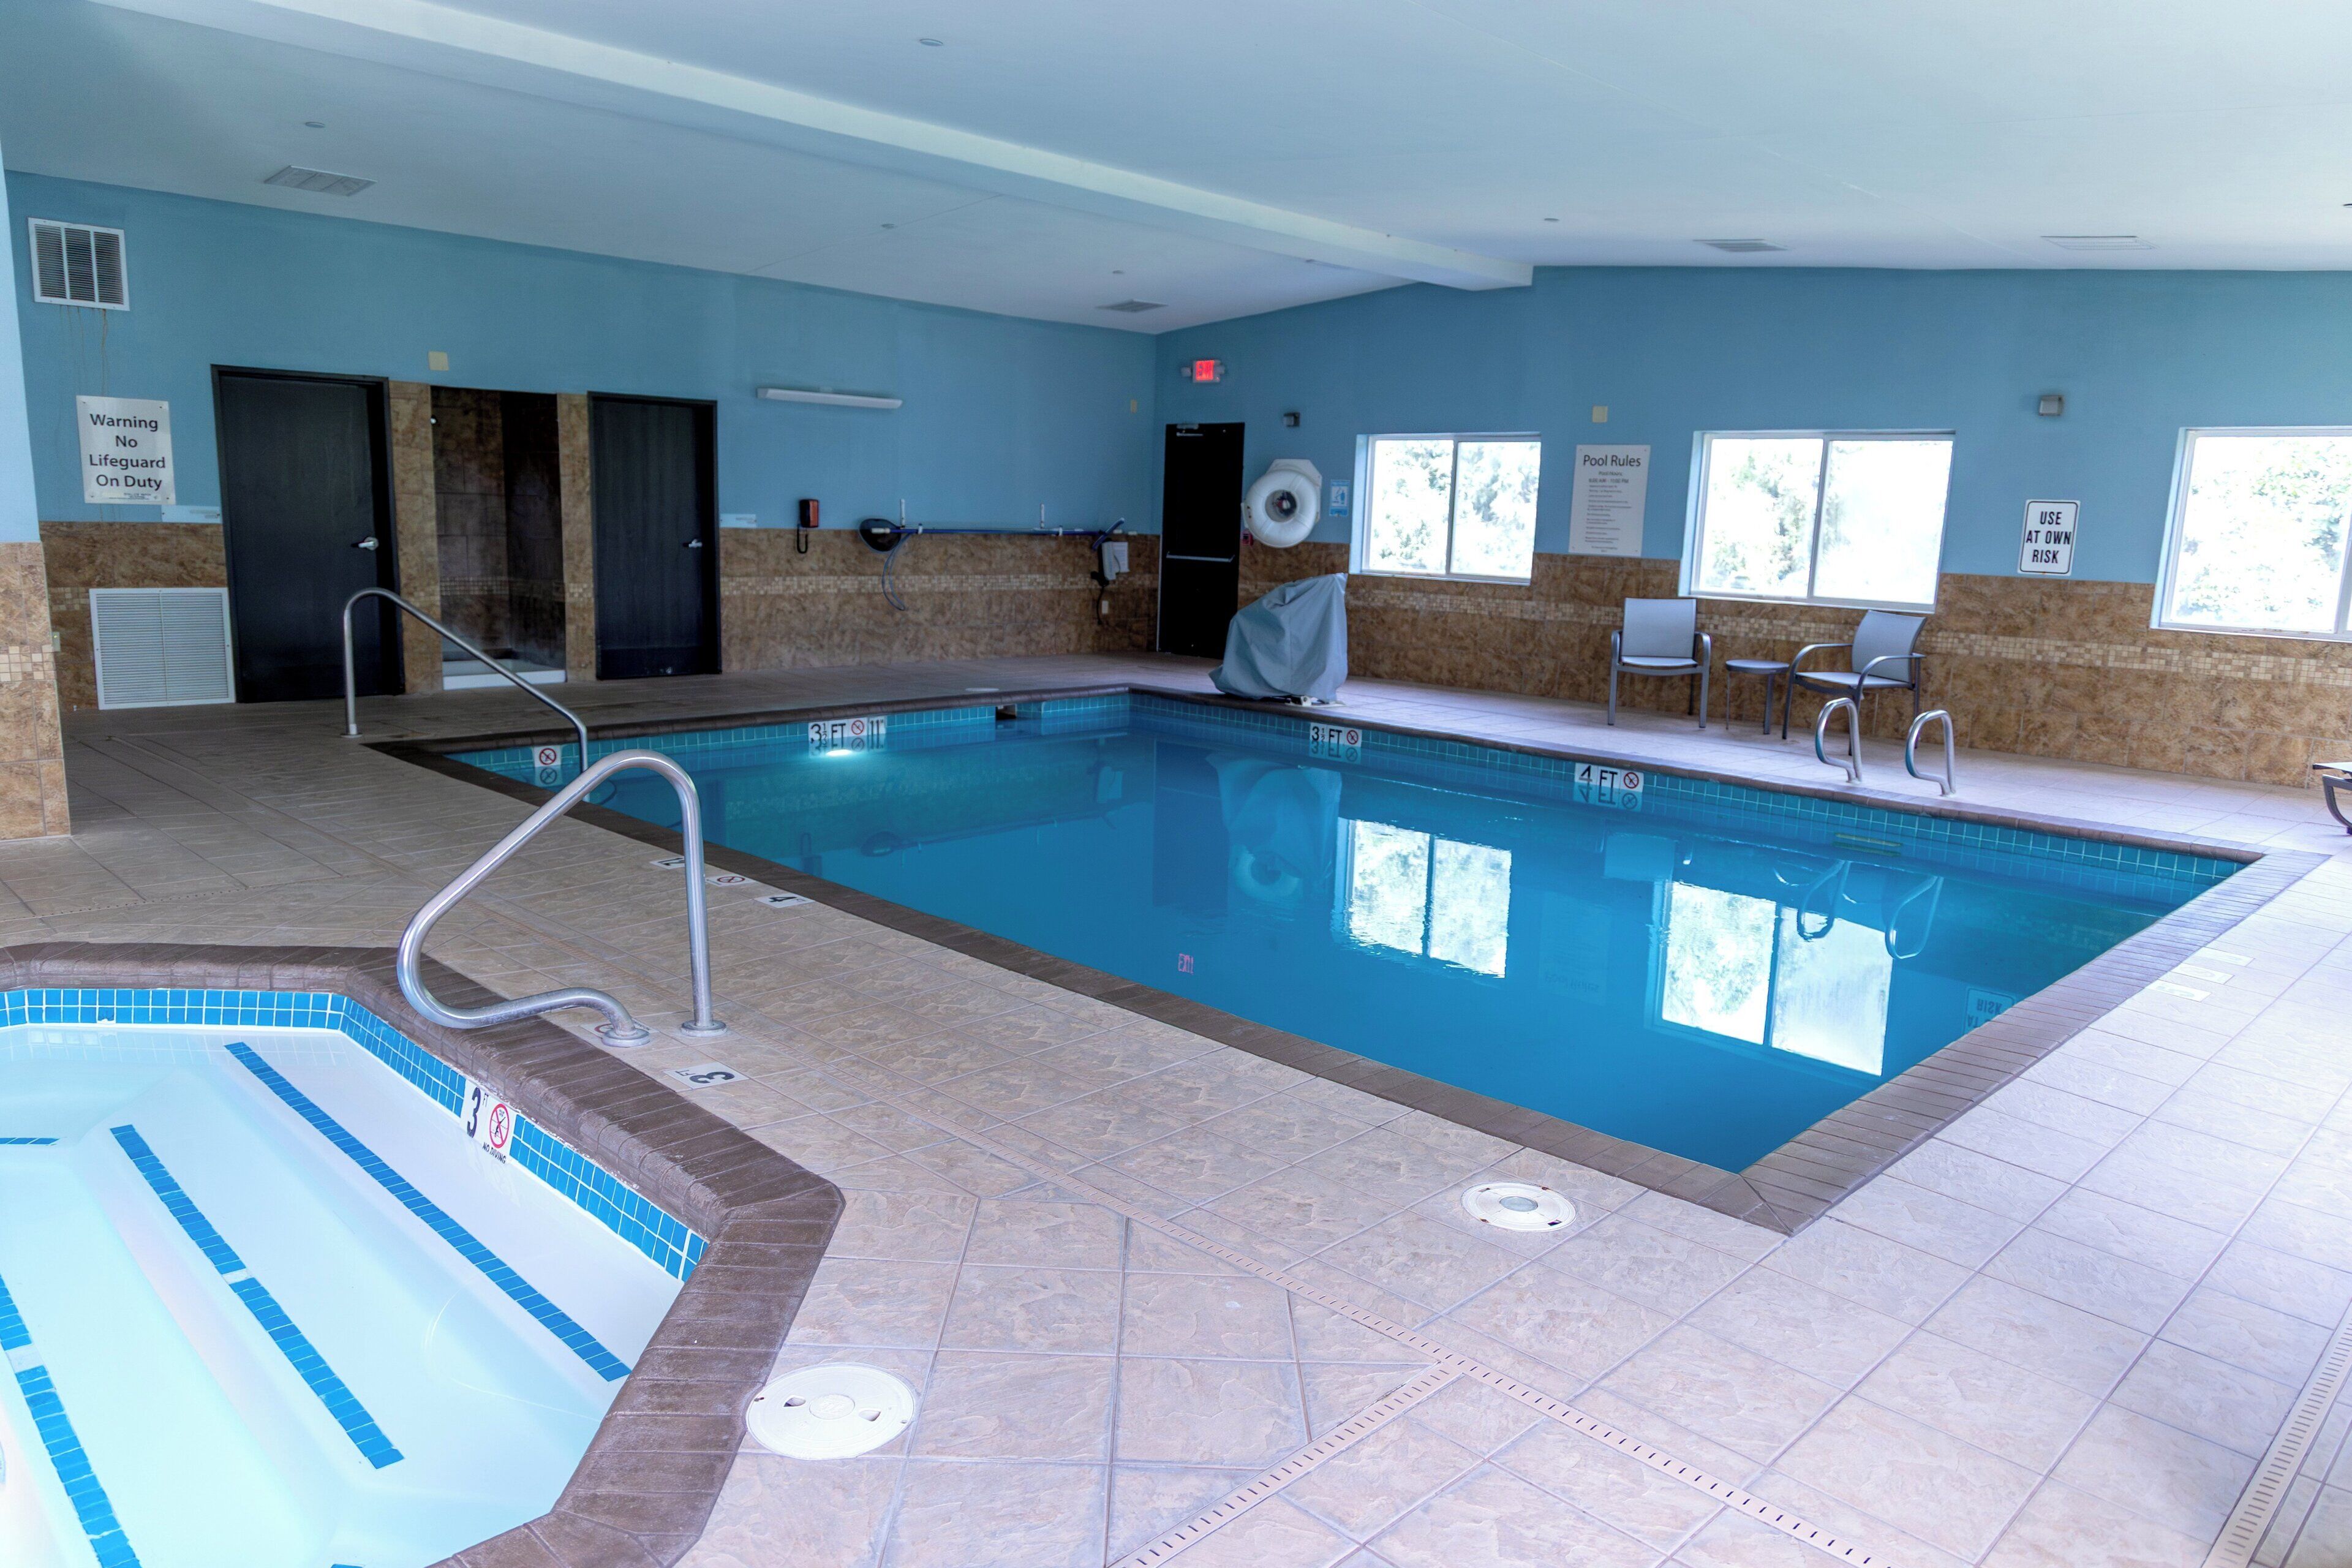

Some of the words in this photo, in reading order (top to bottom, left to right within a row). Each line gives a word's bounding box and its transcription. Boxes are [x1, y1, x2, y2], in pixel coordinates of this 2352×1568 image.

[89, 413, 158, 432] Warning
[116, 435, 138, 448] No
[89, 454, 165, 470] Lifeguard
[1583, 454, 1608, 466] Pool
[1611, 454, 1642, 466] Rules
[96, 474, 119, 487] On
[124, 475, 162, 491] Duty
[2040, 511, 2062, 525] USE
[2026, 530, 2041, 543] AT
[2045, 530, 2071, 545] OWN
[2032, 549, 2059, 564] RISK
[832, 723, 846, 738] FT
[1329, 728, 1343, 744] FT
[1579, 765, 1593, 785] 4
[1599, 769, 1618, 788] FT
[689, 1071, 735, 1084] 3
[467, 1087, 481, 1138] 3
[482, 1092, 489, 1107] FT
[482, 1142, 489, 1152] NO
[489, 1148, 507, 1164] DIVING
